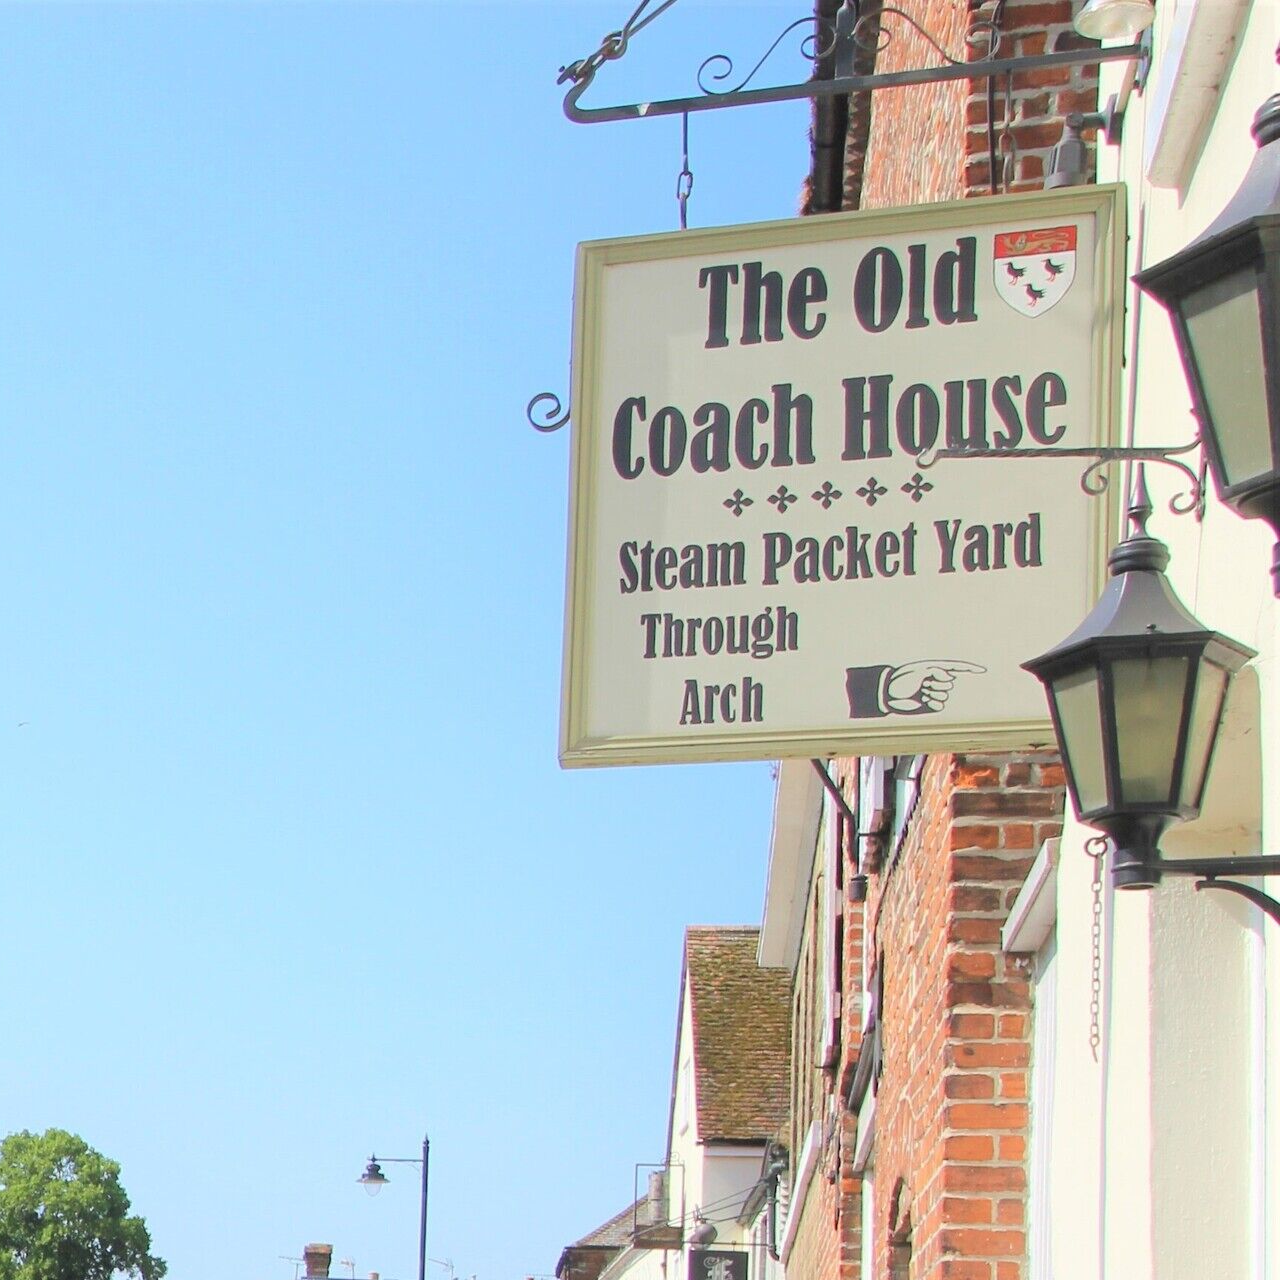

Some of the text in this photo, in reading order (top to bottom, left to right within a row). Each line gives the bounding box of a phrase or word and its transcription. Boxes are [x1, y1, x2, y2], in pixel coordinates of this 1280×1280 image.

[698, 236, 979, 349] The Old
[612, 371, 1068, 480] Coach House
[619, 513, 1043, 594] Steam Packet Yard
[640, 605, 799, 660] Through
[679, 676, 765, 726] Arch
